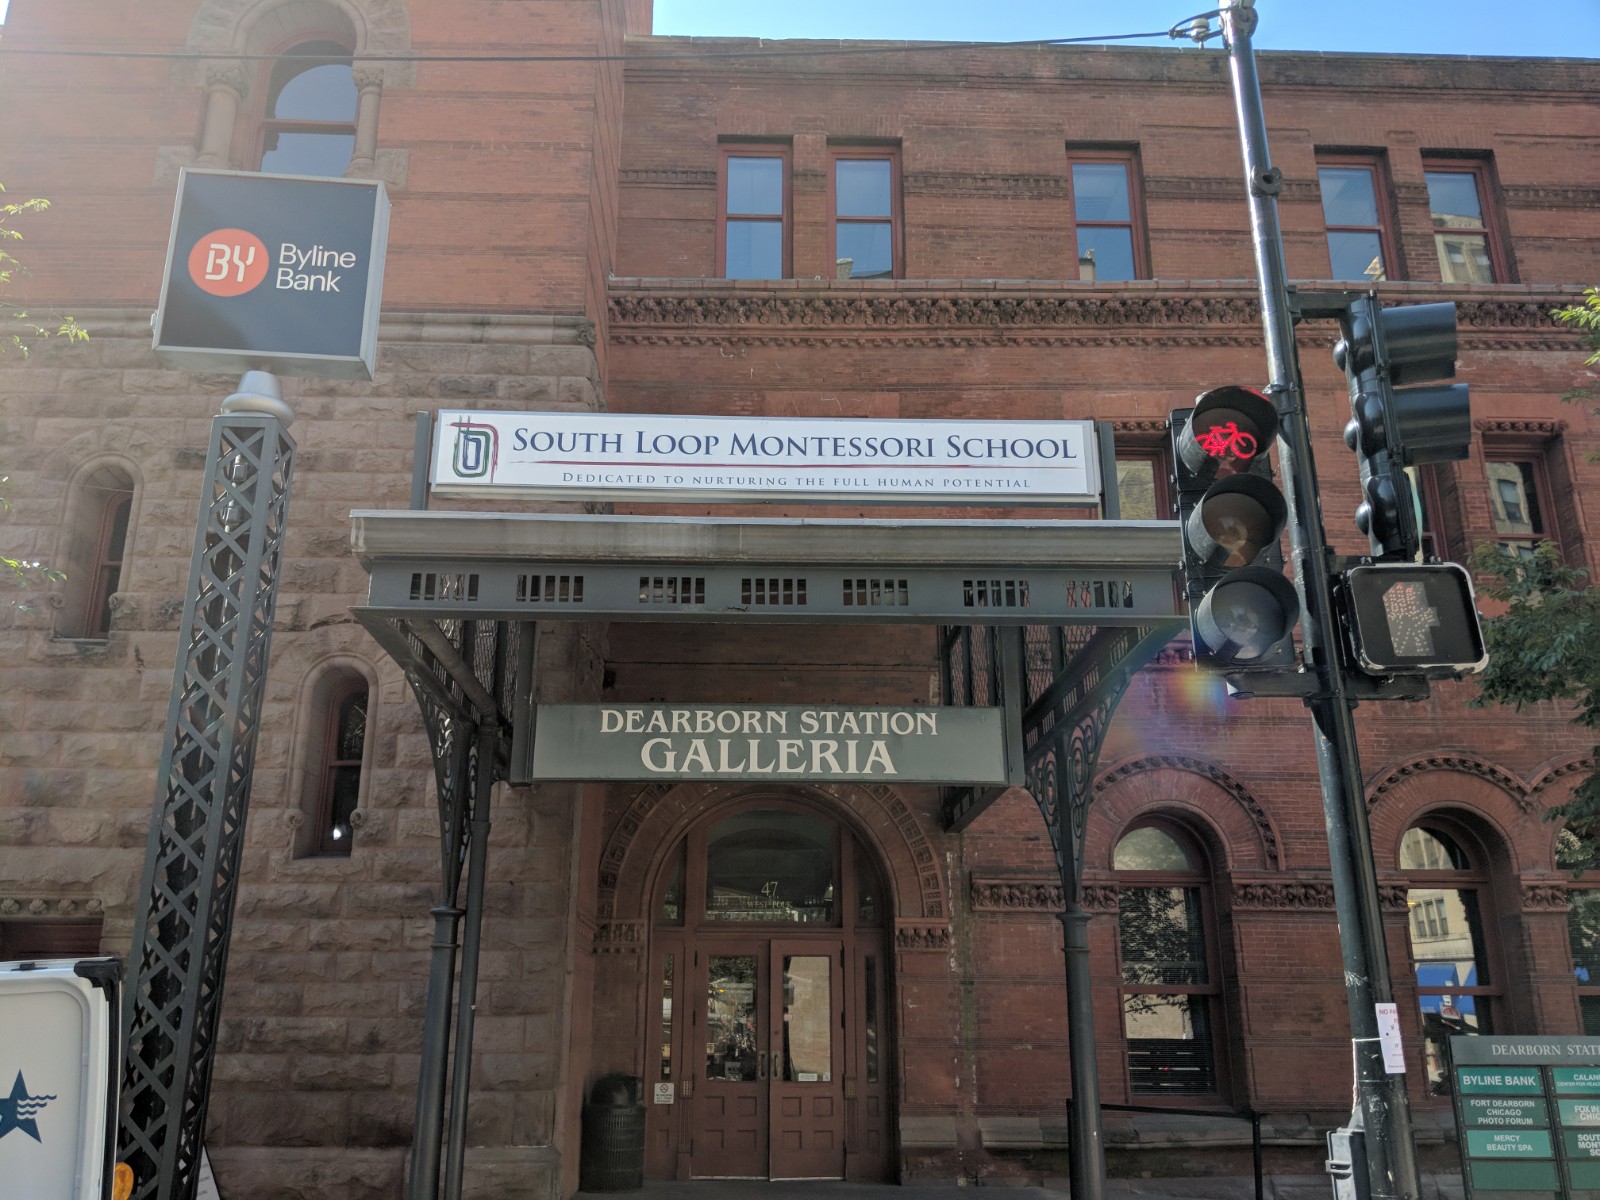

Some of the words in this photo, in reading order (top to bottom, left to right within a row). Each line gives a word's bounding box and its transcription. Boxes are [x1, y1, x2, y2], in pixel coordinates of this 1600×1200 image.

[205, 243, 256, 282] BY
[279, 243, 357, 271] Byline
[275, 268, 341, 292] Bank
[512, 427, 624, 454] SOUTH
[635, 430, 720, 456] LOOP
[728, 432, 936, 458] MONTESSORI
[946, 434, 1078, 459] SCHOOL
[562, 472, 656, 484] DEDICATED
[663, 475, 684, 485] TO
[691, 475, 788, 486] NURTURING
[795, 477, 826, 487] THE
[833, 477, 870, 487] FULL
[877, 478, 935, 488] HUMAN
[943, 478, 1032, 489] POTENTIAL
[600, 709, 789, 735] DEARBORN
[799, 710, 939, 736] STATION
[640, 737, 899, 775] GALLERIA
[761, 881, 779, 897] 47
[1491, 1044, 1562, 1056] DEARBORN
[1462, 1075, 1503, 1086] BYLINE
[1505, 1075, 1537, 1087] BANK
[1470, 1100, 1491, 1108] FORT
[1492, 1100, 1535, 1108] DEARBORN
[1574, 1105, 1590, 1113] FOX
[1486, 1108, 1522, 1117] CHICAGO
[1477, 1117, 1505, 1125] PHOTO
[1505, 1117, 1534, 1126] FORUM
[1493, 1134, 1520, 1142] MERCY
[1486, 1143, 1516, 1152] BEAUTY
[1517, 1144, 1533, 1152] SPA
